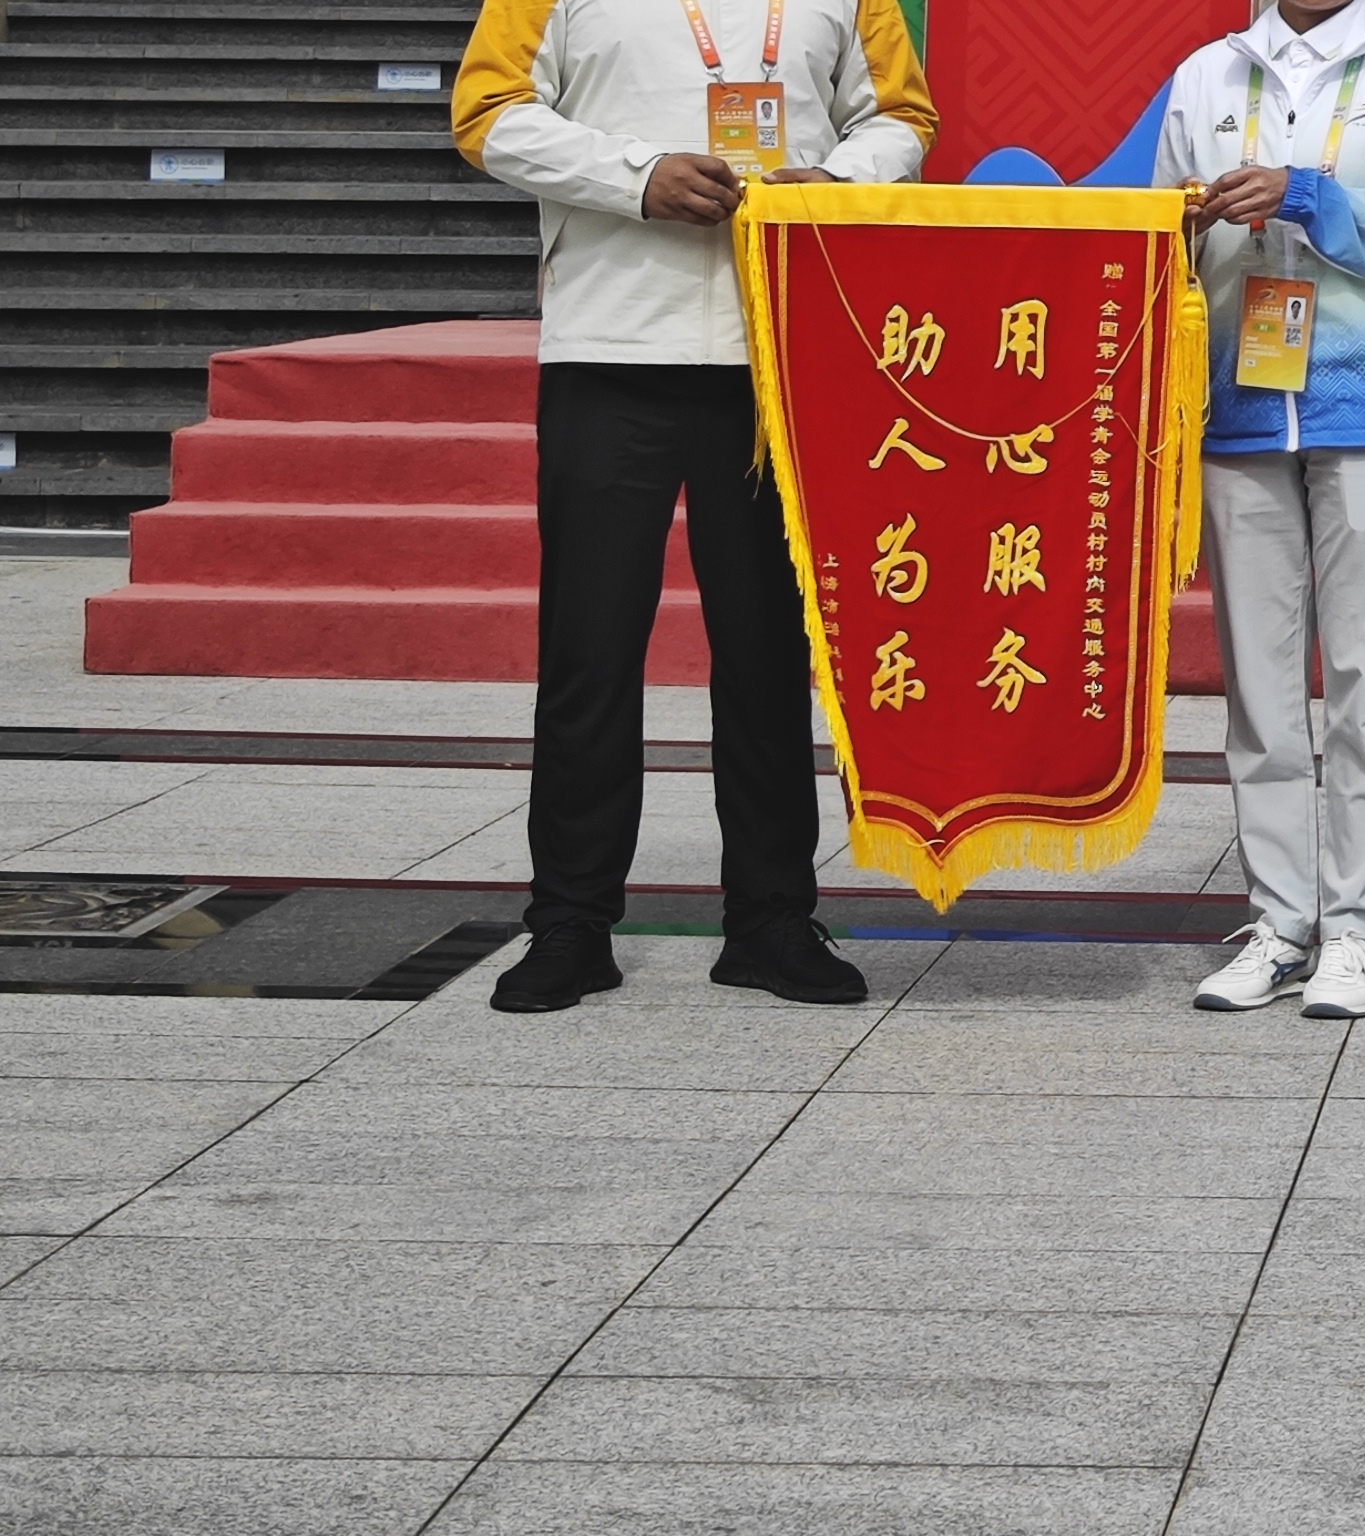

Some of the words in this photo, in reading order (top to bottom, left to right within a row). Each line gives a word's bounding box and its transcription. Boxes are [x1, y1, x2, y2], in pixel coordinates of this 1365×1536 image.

[868, 302, 946, 714] 助人为乐
[976, 299, 1055, 714] 用心服务
